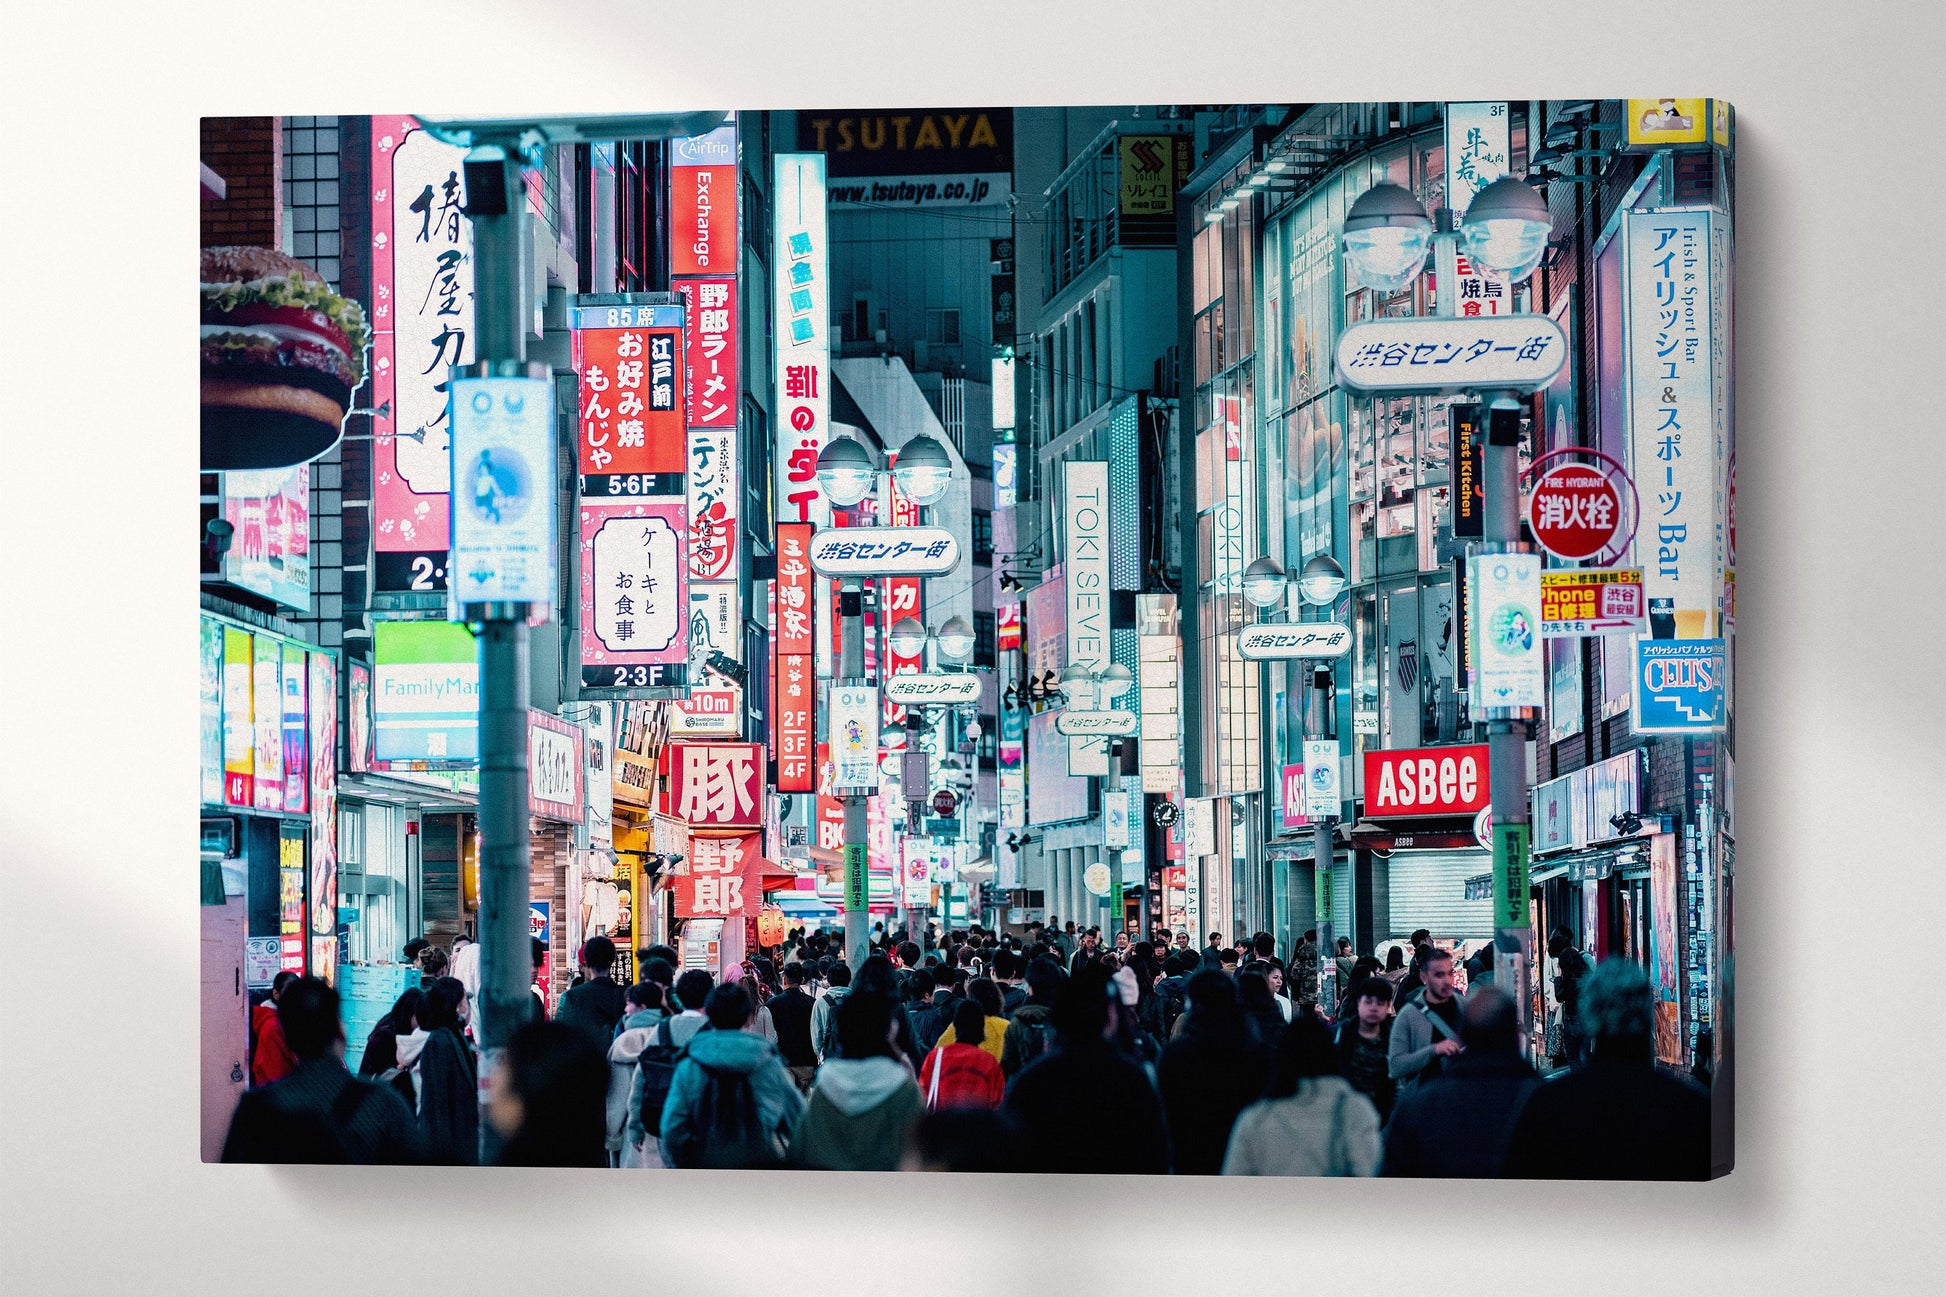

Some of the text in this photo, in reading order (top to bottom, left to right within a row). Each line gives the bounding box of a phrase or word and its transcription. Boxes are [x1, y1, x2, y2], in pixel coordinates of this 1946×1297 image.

[1490, 105, 1505, 117] 3F
[687, 142, 729, 157] AirTrip
[811, 114, 999, 151] TSUTAYA
[1127, 184, 1168, 198] ソレイユ
[693, 171, 712, 267] Exchange
[1681, 227, 1699, 364] Irish & Sport Bar
[699, 283, 729, 423] 野郎ラーメン
[1349, 335, 1553, 368] 渋谷センター街
[617, 331, 645, 448] お好み焼
[651, 338, 672, 407] 江戸前
[584, 364, 613, 470] もんじゃ
[1460, 422, 1472, 518] First Kitchen
[1544, 477, 1605, 489] FIRE HYDRANT
[1075, 487, 1100, 561] TOKI
[1537, 493, 1614, 530] 消火栓
[816, 540, 951, 562] 渋谷センター街
[641, 527, 659, 615] ケーキと
[614, 571, 636, 642] お食事
[1541, 587, 1596, 603] Phone
[1607, 587, 1635, 602] 渋谷
[1245, 631, 1346, 649] 渋谷センター街
[385, 677, 480, 700] FamilyMar
[891, 683, 976, 696] 渋谷センター街
[1644, 657, 1712, 693] CELTS
[783, 711, 807, 727] 2F
[783, 736, 807, 752] 3F
[678, 746, 755, 823] 豚
[783, 763, 807, 778] 4F
[1376, 755, 1477, 807] ASBee
[1286, 773, 1306, 818] ASB
[692, 837, 744, 915] 野郎
[1505, 831, 1522, 922] 客引きは犯罪です
